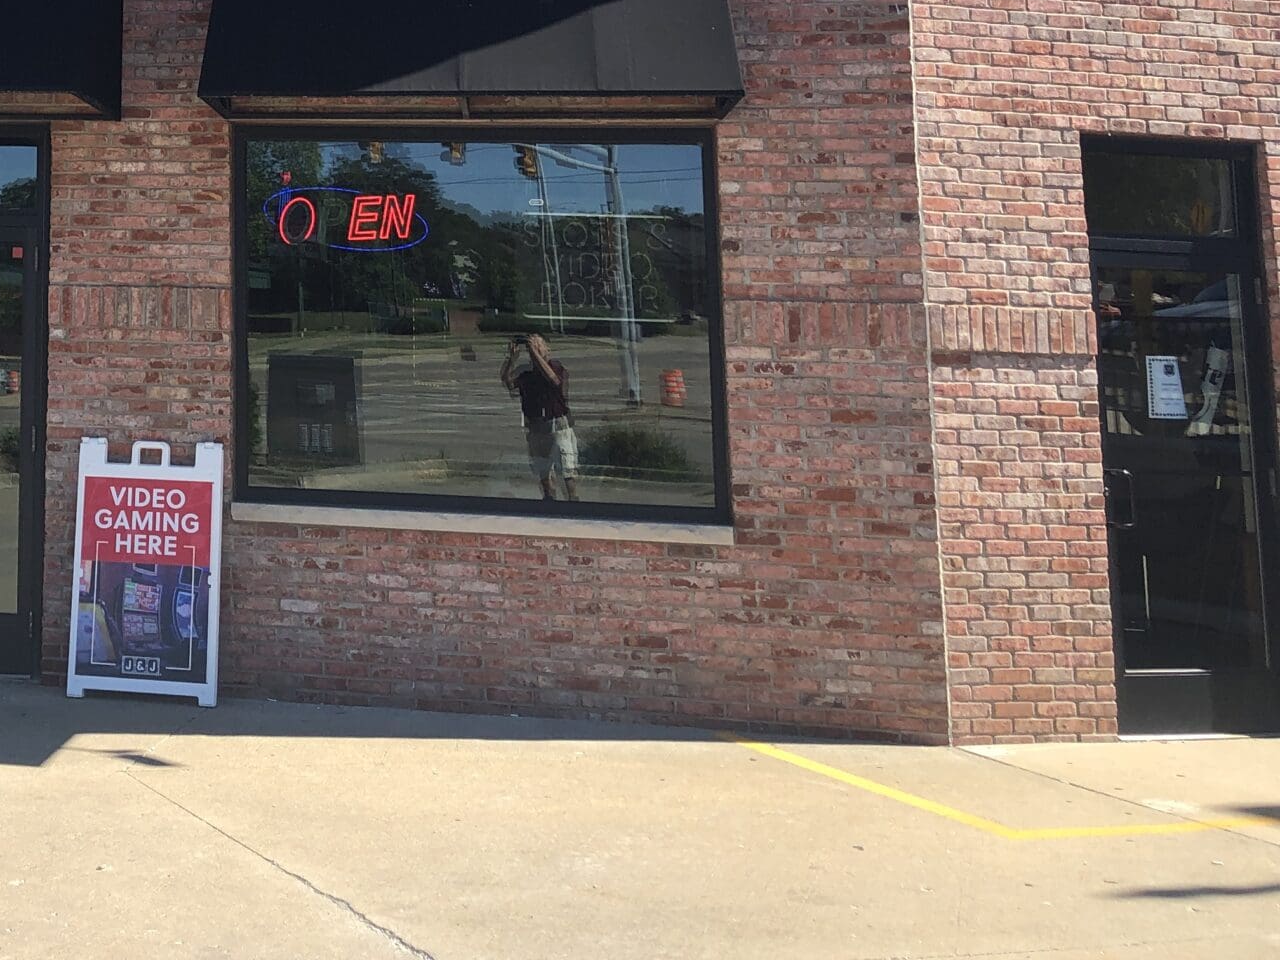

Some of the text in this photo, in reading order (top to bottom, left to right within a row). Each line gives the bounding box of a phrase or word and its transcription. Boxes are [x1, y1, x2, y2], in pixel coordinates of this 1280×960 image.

[543, 251, 653, 281] VIDEO
[540, 281, 659, 313] POKER
[109, 486, 186, 510] VIDEO
[94, 508, 200, 534] GAMING
[115, 533, 178, 556] HERE
